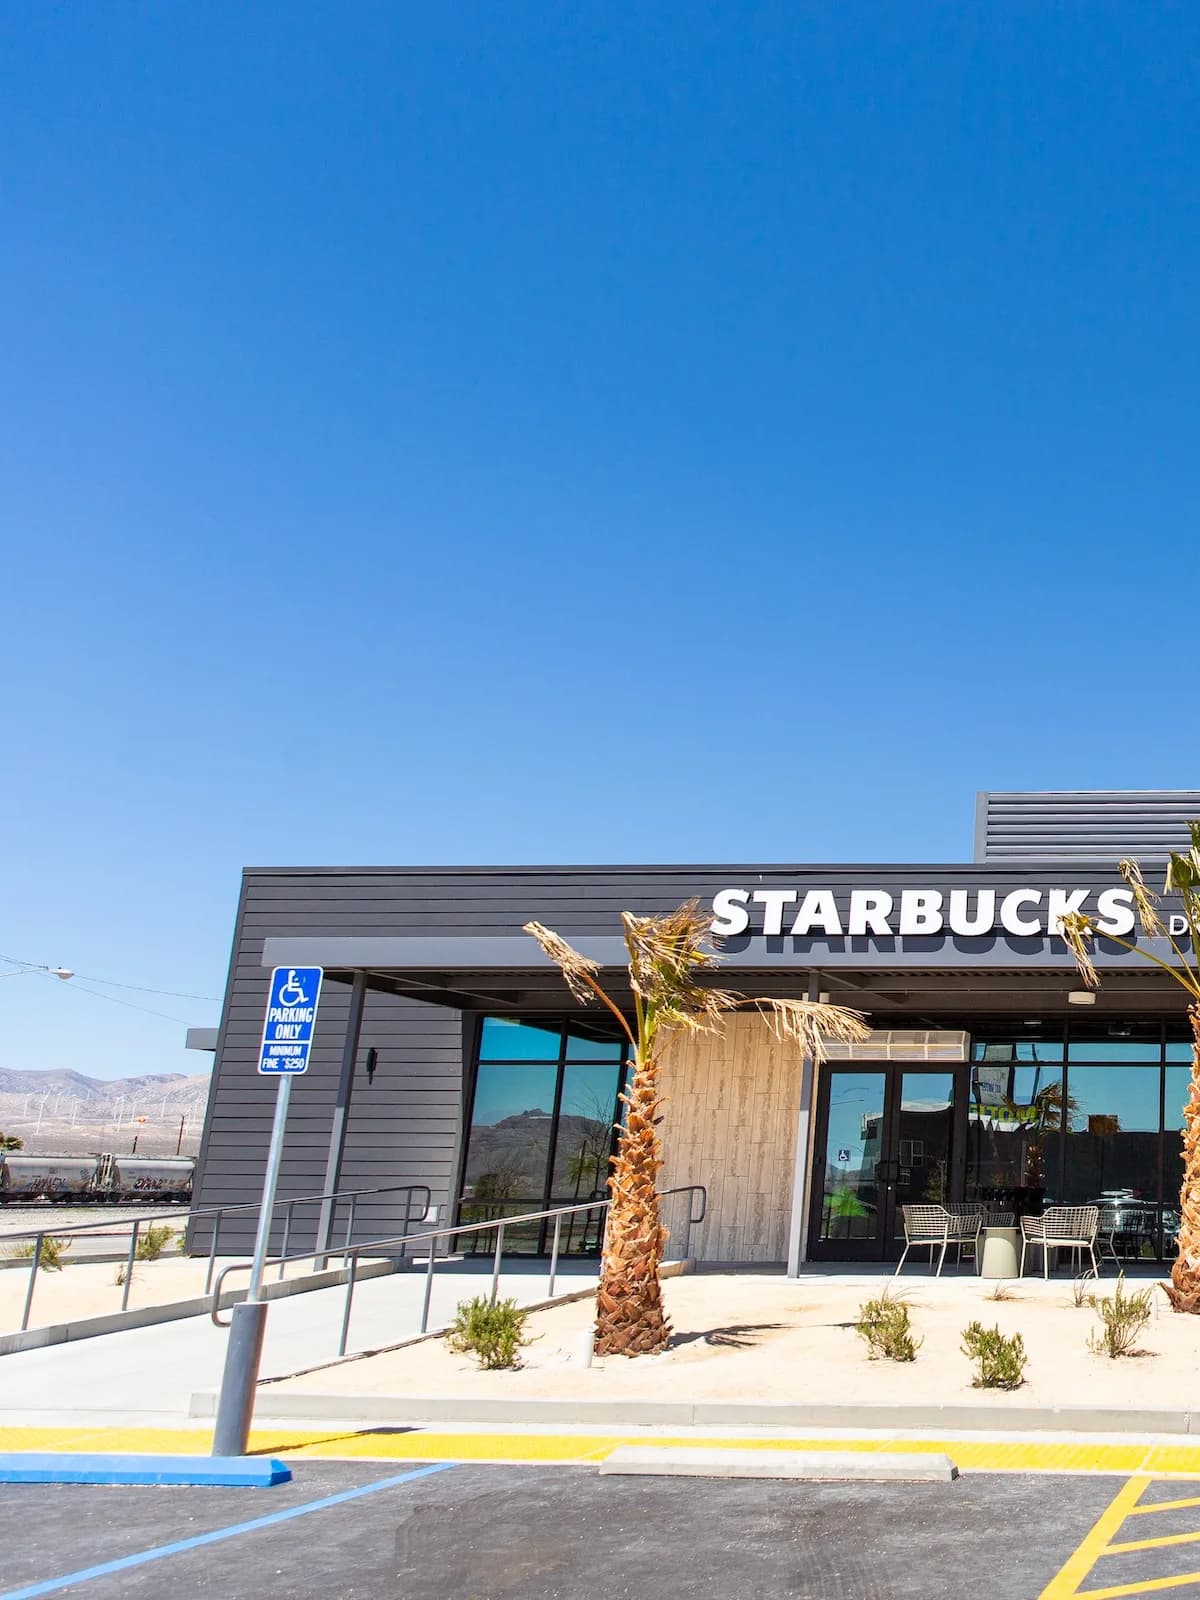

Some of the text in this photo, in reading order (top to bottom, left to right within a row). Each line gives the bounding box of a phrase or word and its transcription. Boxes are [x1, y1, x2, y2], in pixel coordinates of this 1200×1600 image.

[710, 888, 1135, 936] STARBUCKS
[268, 1007, 314, 1022] PARKING
[275, 1023, 302, 1039] ONLY
[269, 1045, 302, 1056] MINIMUM
[262, 1058, 280, 1069] FINE
